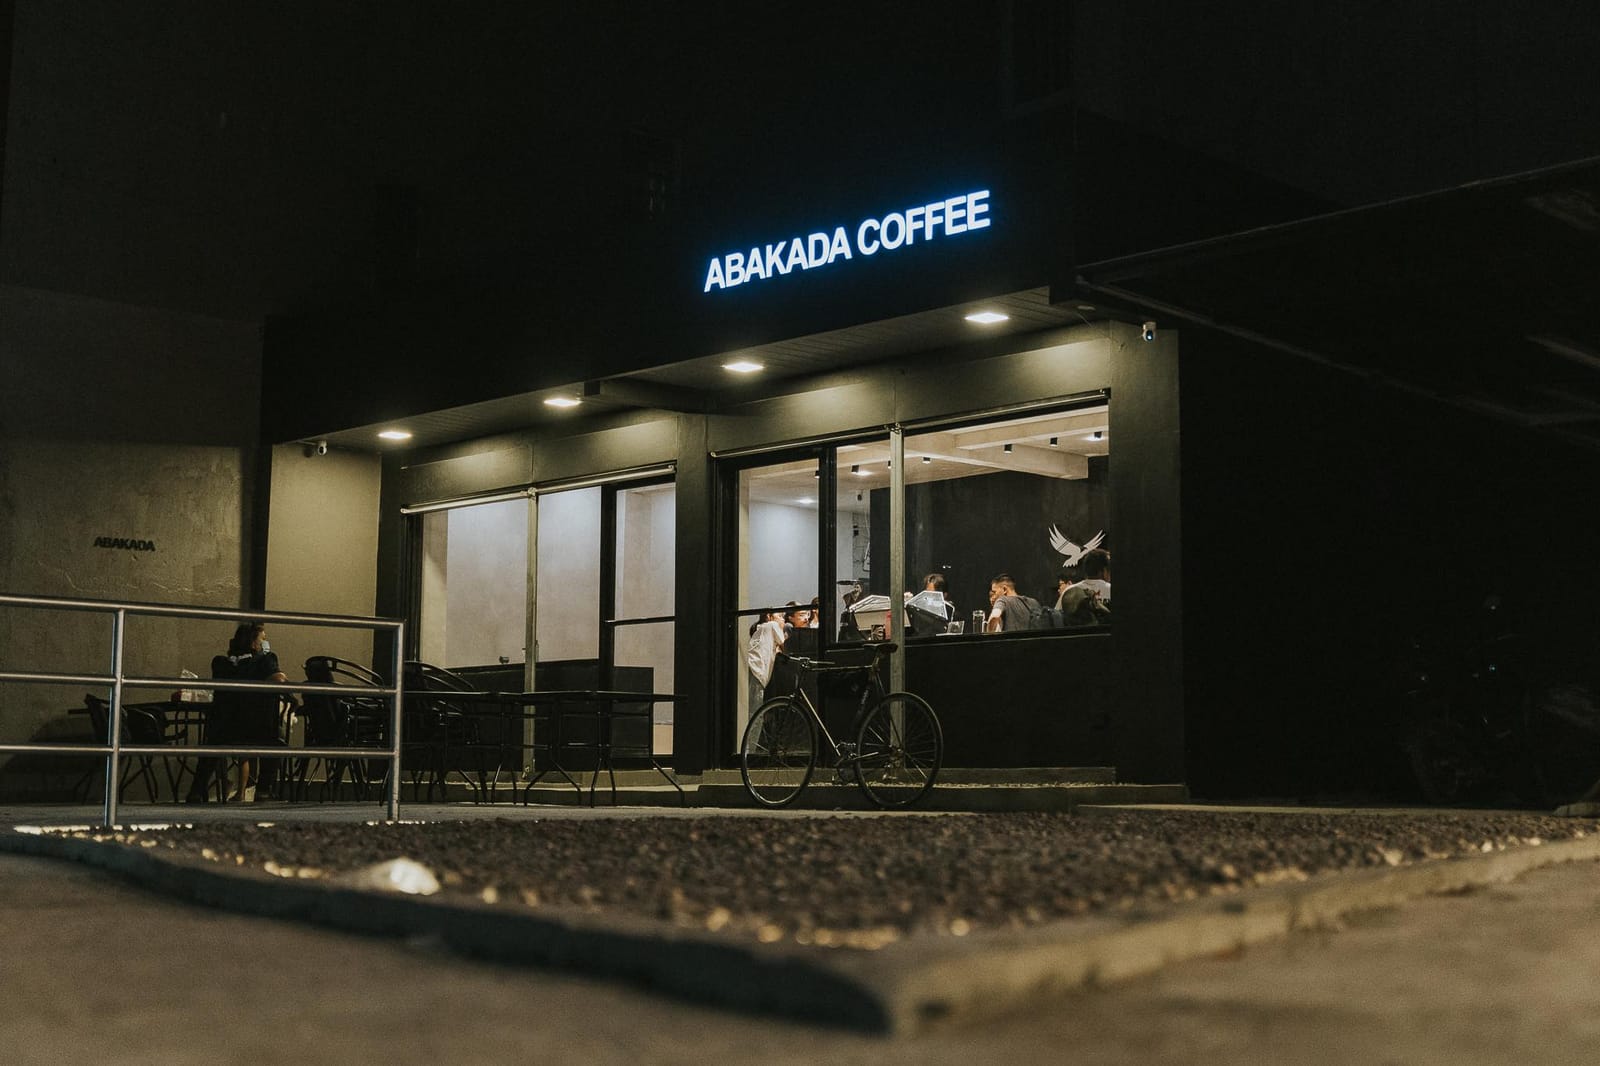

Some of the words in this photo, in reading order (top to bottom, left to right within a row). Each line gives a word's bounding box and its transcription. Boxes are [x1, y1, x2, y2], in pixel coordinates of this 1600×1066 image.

[704, 226, 852, 293] ABAKADA
[857, 189, 991, 255] COFFEE
[93, 536, 156, 552] ABAKADA
